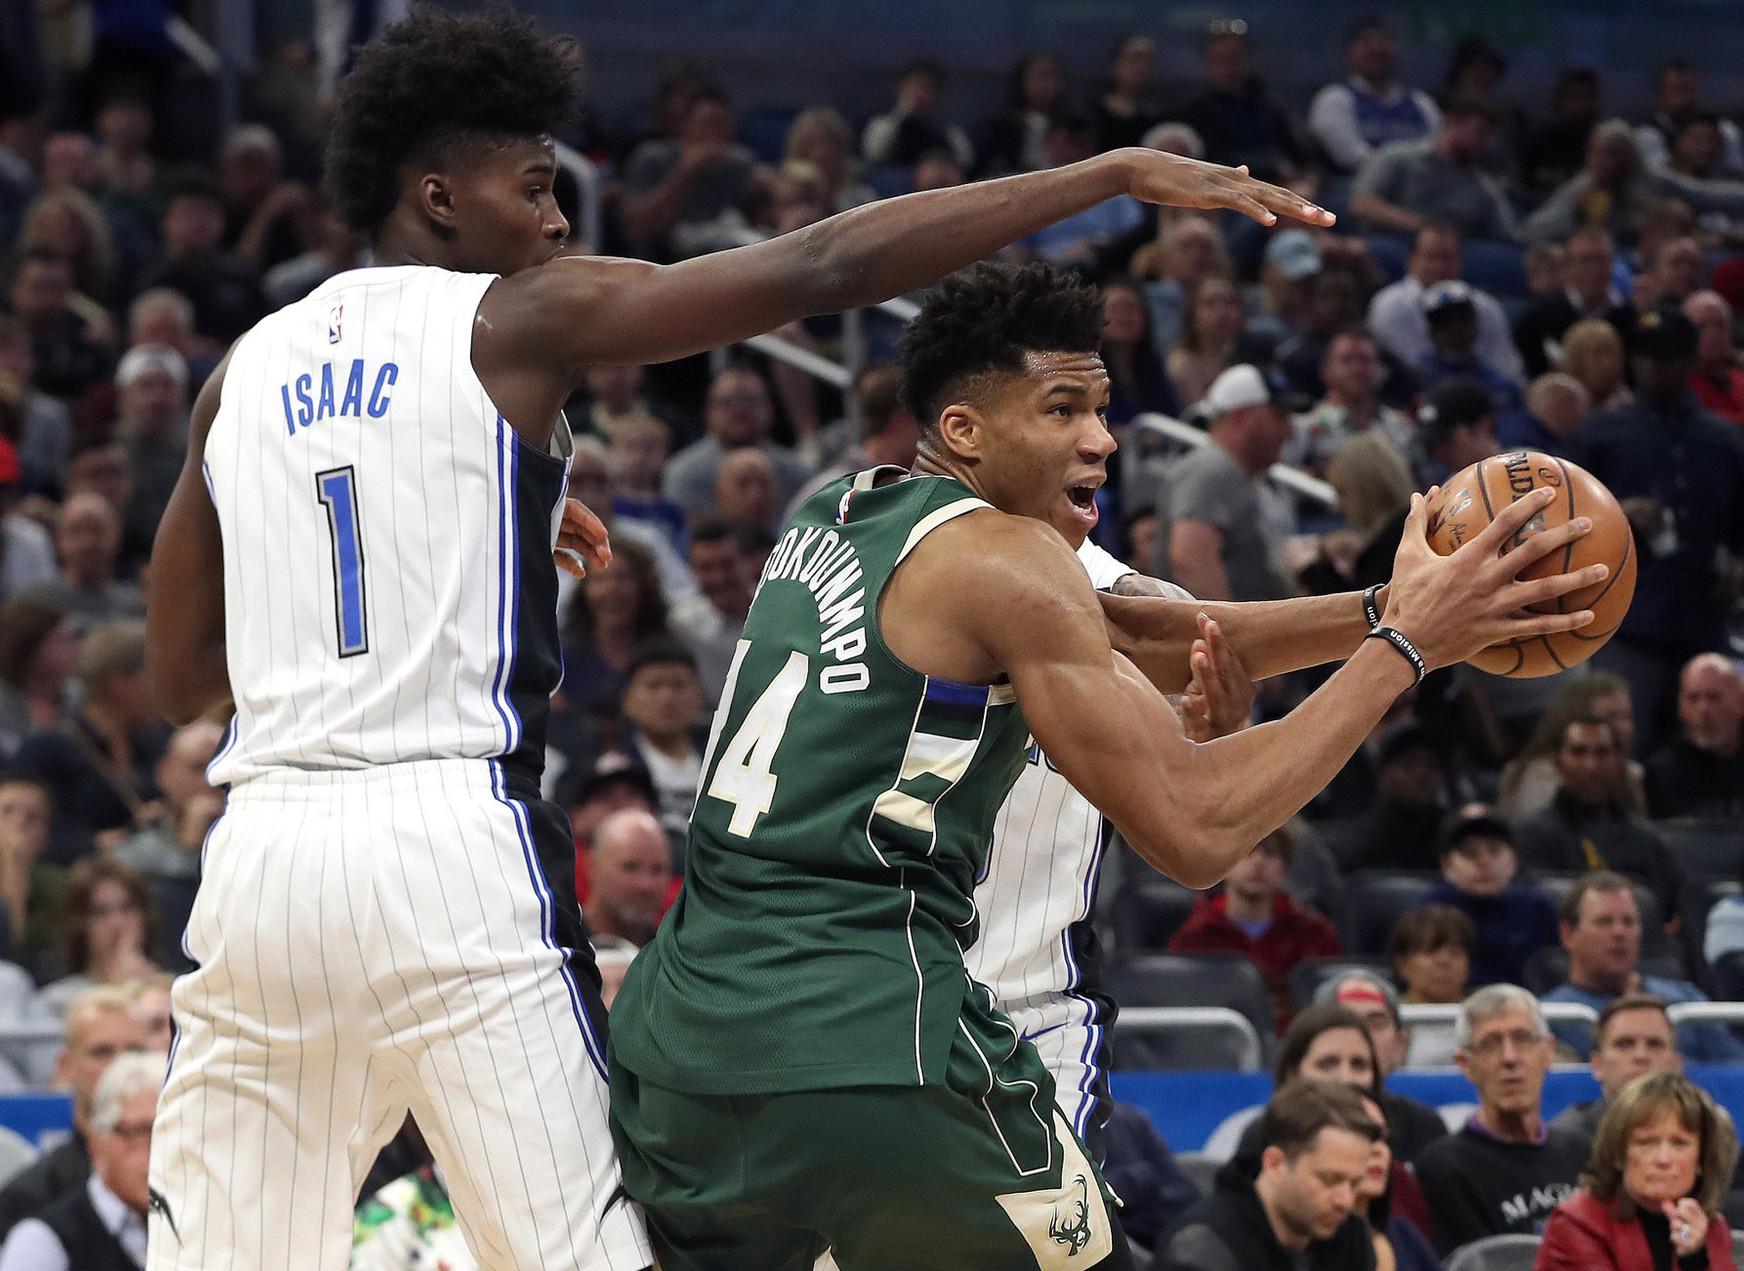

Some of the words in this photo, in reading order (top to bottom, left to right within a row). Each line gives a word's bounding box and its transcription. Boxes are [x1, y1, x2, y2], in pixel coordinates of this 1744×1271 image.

[280, 358, 399, 436] ISAAC
[315, 464, 369, 660] 1
[750, 526, 871, 695] OKOUNMPO
[1389, 630, 1421, 663] Mission
